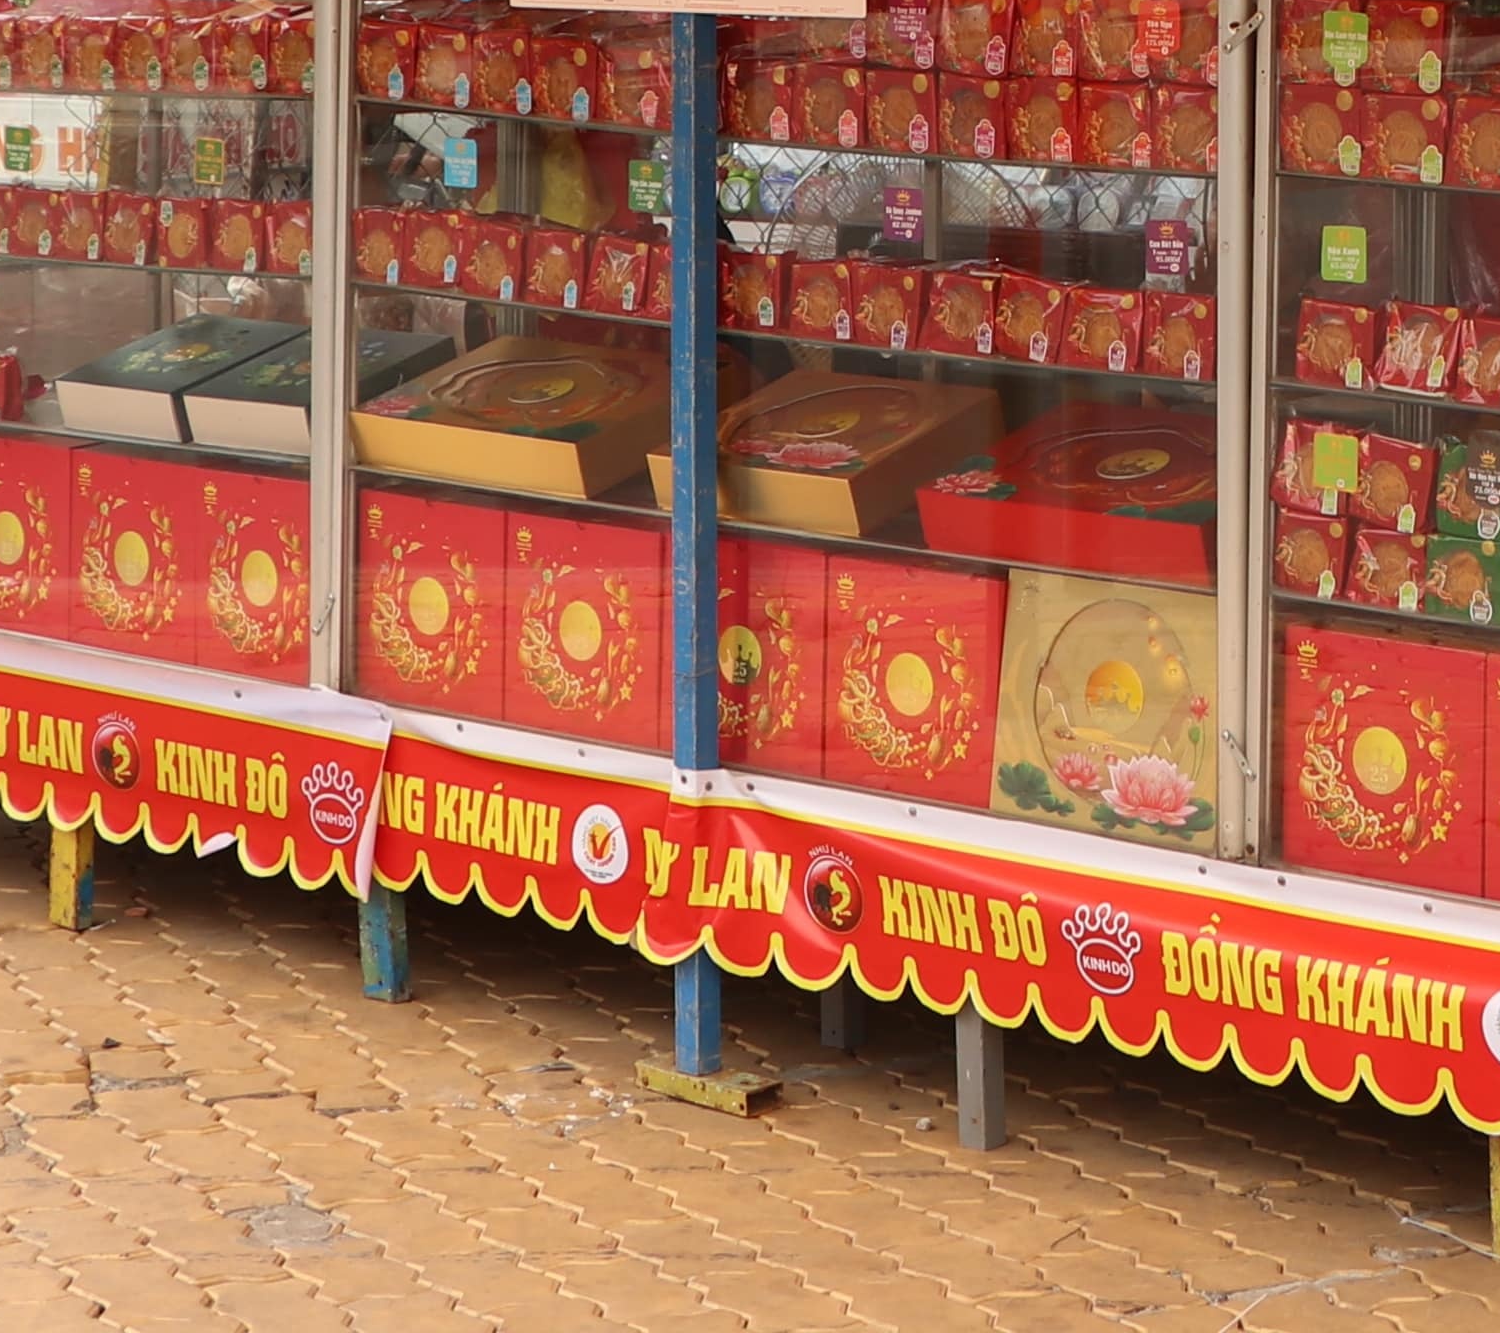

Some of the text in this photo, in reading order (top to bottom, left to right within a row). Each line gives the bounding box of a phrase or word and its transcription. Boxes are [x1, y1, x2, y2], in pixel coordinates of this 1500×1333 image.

[16, 709, 85, 776] LAN
[154, 738, 290, 820] KINH ĐÔ
[433, 781, 562, 866] KHÁNH
[686, 845, 793, 916] LAN
[877, 873, 1047, 968] KINH ĐÔ
[1160, 912, 1468, 1053] ĐỒNG KHÁNH
